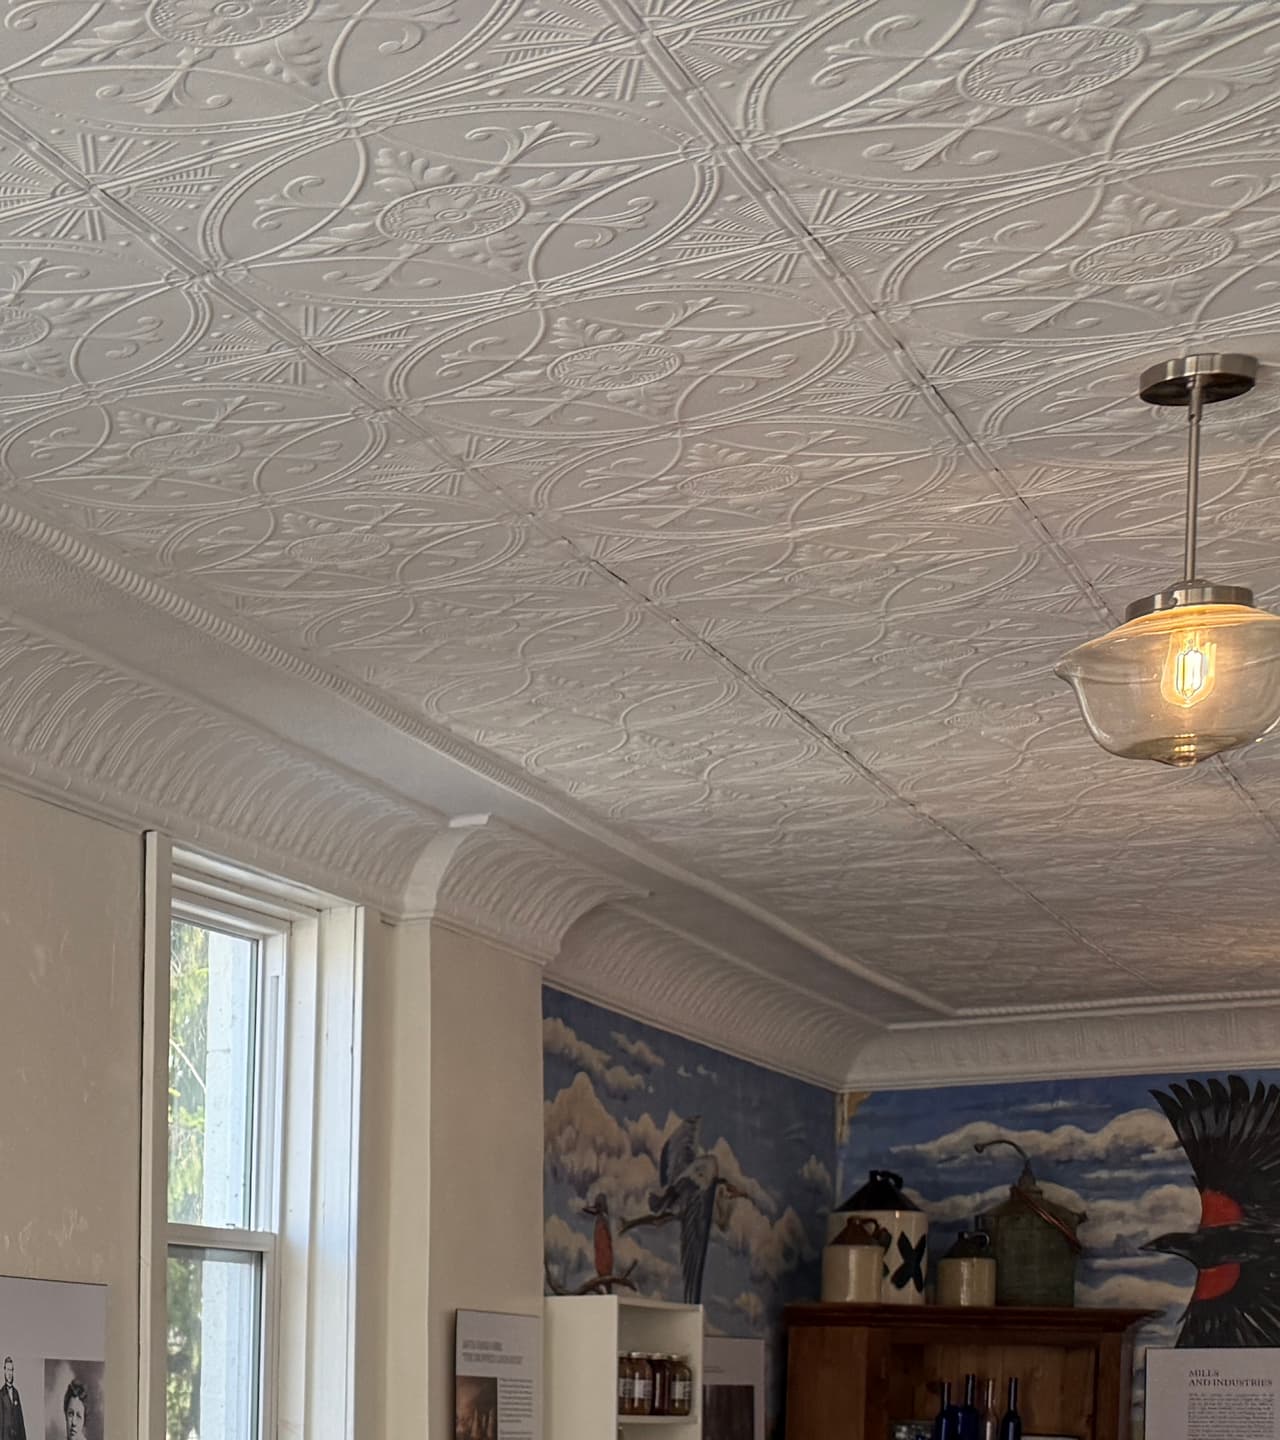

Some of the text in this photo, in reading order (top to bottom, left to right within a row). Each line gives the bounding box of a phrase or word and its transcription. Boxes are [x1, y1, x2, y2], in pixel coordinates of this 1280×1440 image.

[1188, 1369, 1219, 1377] MILLS
[1188, 1379, 1273, 1387] AND INDUSTRIES
